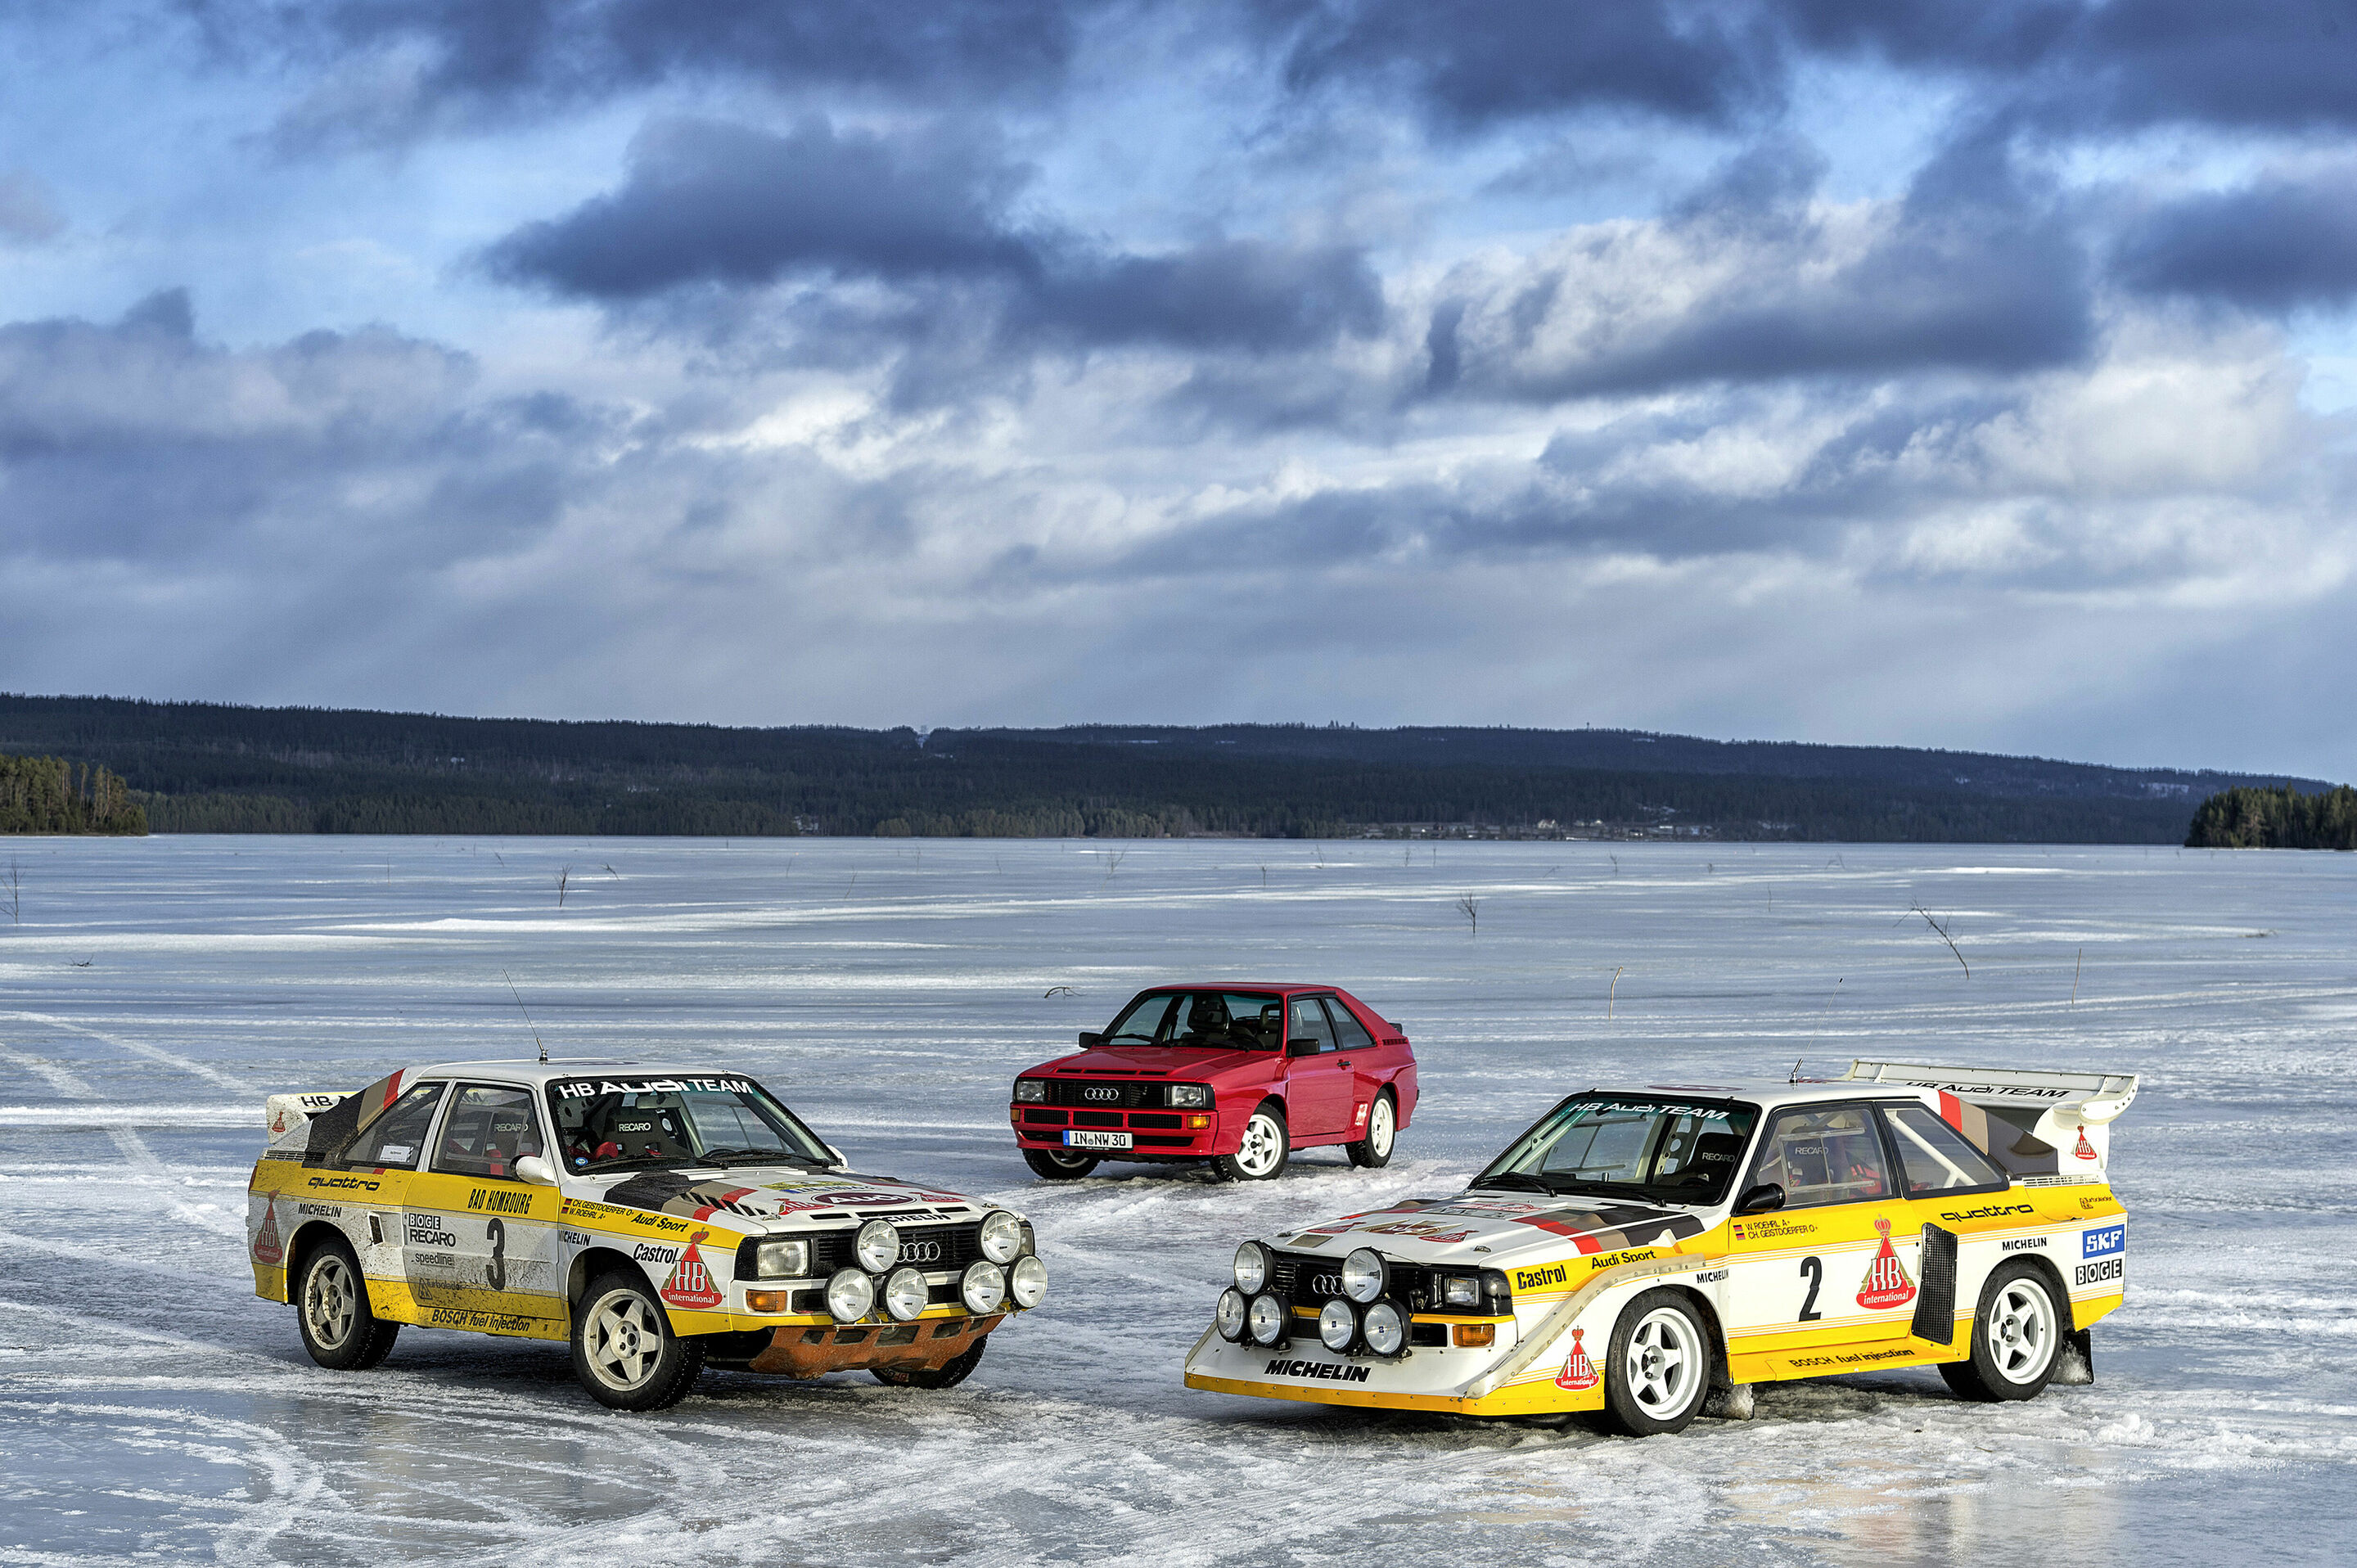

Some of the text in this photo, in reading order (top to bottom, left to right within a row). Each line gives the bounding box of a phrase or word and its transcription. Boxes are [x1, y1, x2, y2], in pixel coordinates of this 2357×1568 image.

[558, 1082, 596, 1099] HB
[686, 1079, 754, 1094] TEAM
[1938, 1084, 1994, 1093] Audi
[1998, 1087, 2071, 1098] TEAM
[300, 1096, 333, 1106] HB
[1568, 1102, 1730, 1120] HB Audi TEAM
[618, 1122, 651, 1132] RECARO
[1074, 1133, 1126, 1147] IN NW 30
[1701, 1151, 1736, 1163] RECARO
[308, 1176, 380, 1192] quattro
[298, 1203, 342, 1219] MICHELIN
[467, 1188, 533, 1215] BAD HOMBOURG
[409, 1213, 441, 1229] BOGE
[631, 1213, 689, 1232] Audi Sport
[1940, 1204, 2034, 1223] quattro
[260, 1219, 277, 1247] HB
[410, 1229, 456, 1247] RECARO
[2085, 1230, 2123, 1252] SKF
[633, 1243, 680, 1264] Castrol
[2002, 1237, 2048, 1251] MICHELIN
[415, 1252, 453, 1266] speedline
[485, 1218, 506, 1291] 3
[1591, 1250, 1656, 1270] Audi Sport
[675, 1260, 707, 1293] HB
[1517, 1264, 1567, 1290] Castrol
[1870, 1256, 1903, 1292] HB
[2075, 1259, 2122, 1286] BOGE
[668, 1291, 715, 1304] international
[1798, 1255, 1823, 1322] 2
[1863, 1290, 1909, 1305] international
[431, 1309, 530, 1332] BOSCH fuel injection
[1566, 1354, 1589, 1377] HB
[1788, 1349, 1916, 1368] BOSCH fuel injection
[1264, 1359, 1372, 1383] MICHELIN
